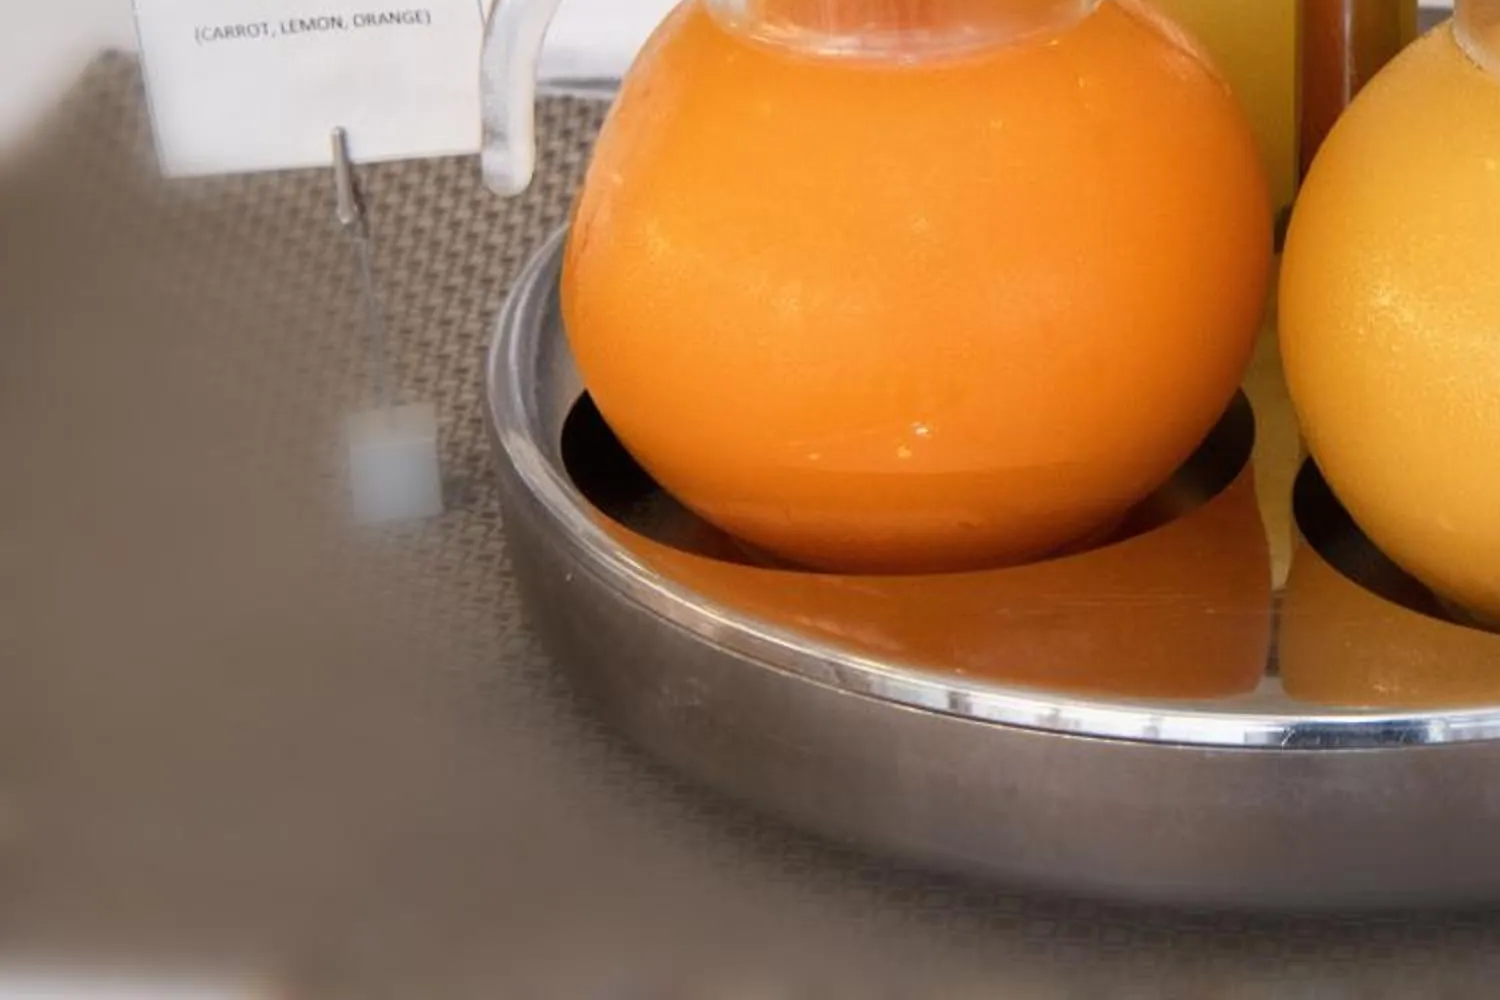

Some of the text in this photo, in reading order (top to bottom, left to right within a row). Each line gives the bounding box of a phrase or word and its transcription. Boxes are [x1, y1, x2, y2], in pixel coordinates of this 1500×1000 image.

[194, 9, 431, 45] (CARROT, LEMON, ORANGE)
